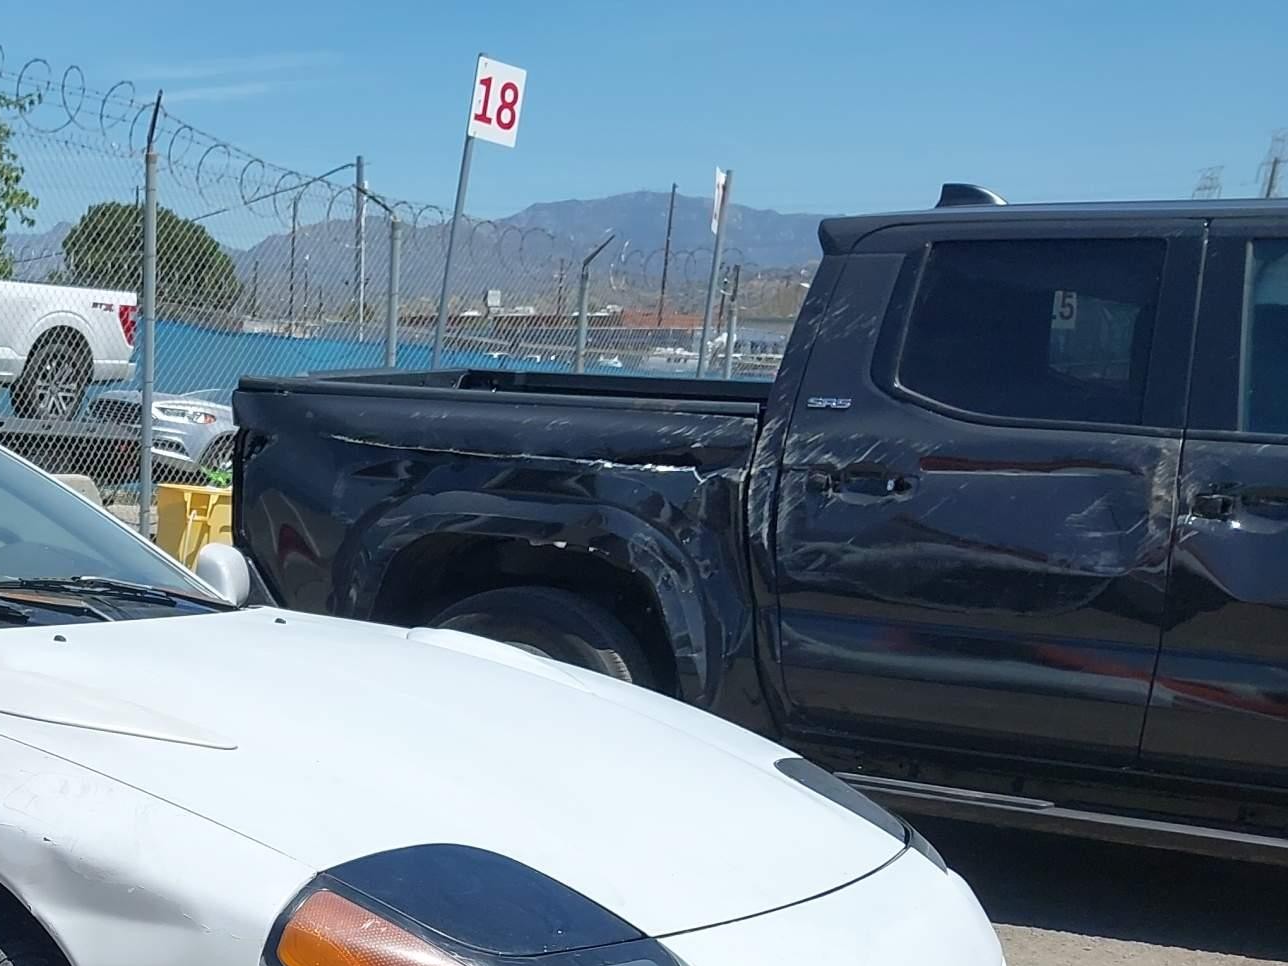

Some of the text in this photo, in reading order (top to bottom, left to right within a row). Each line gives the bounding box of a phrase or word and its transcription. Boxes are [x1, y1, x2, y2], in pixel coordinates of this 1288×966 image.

[474, 76, 519, 130] 18
[1052, 290, 1075, 321] 5
[807, 397, 852, 408] SR5
